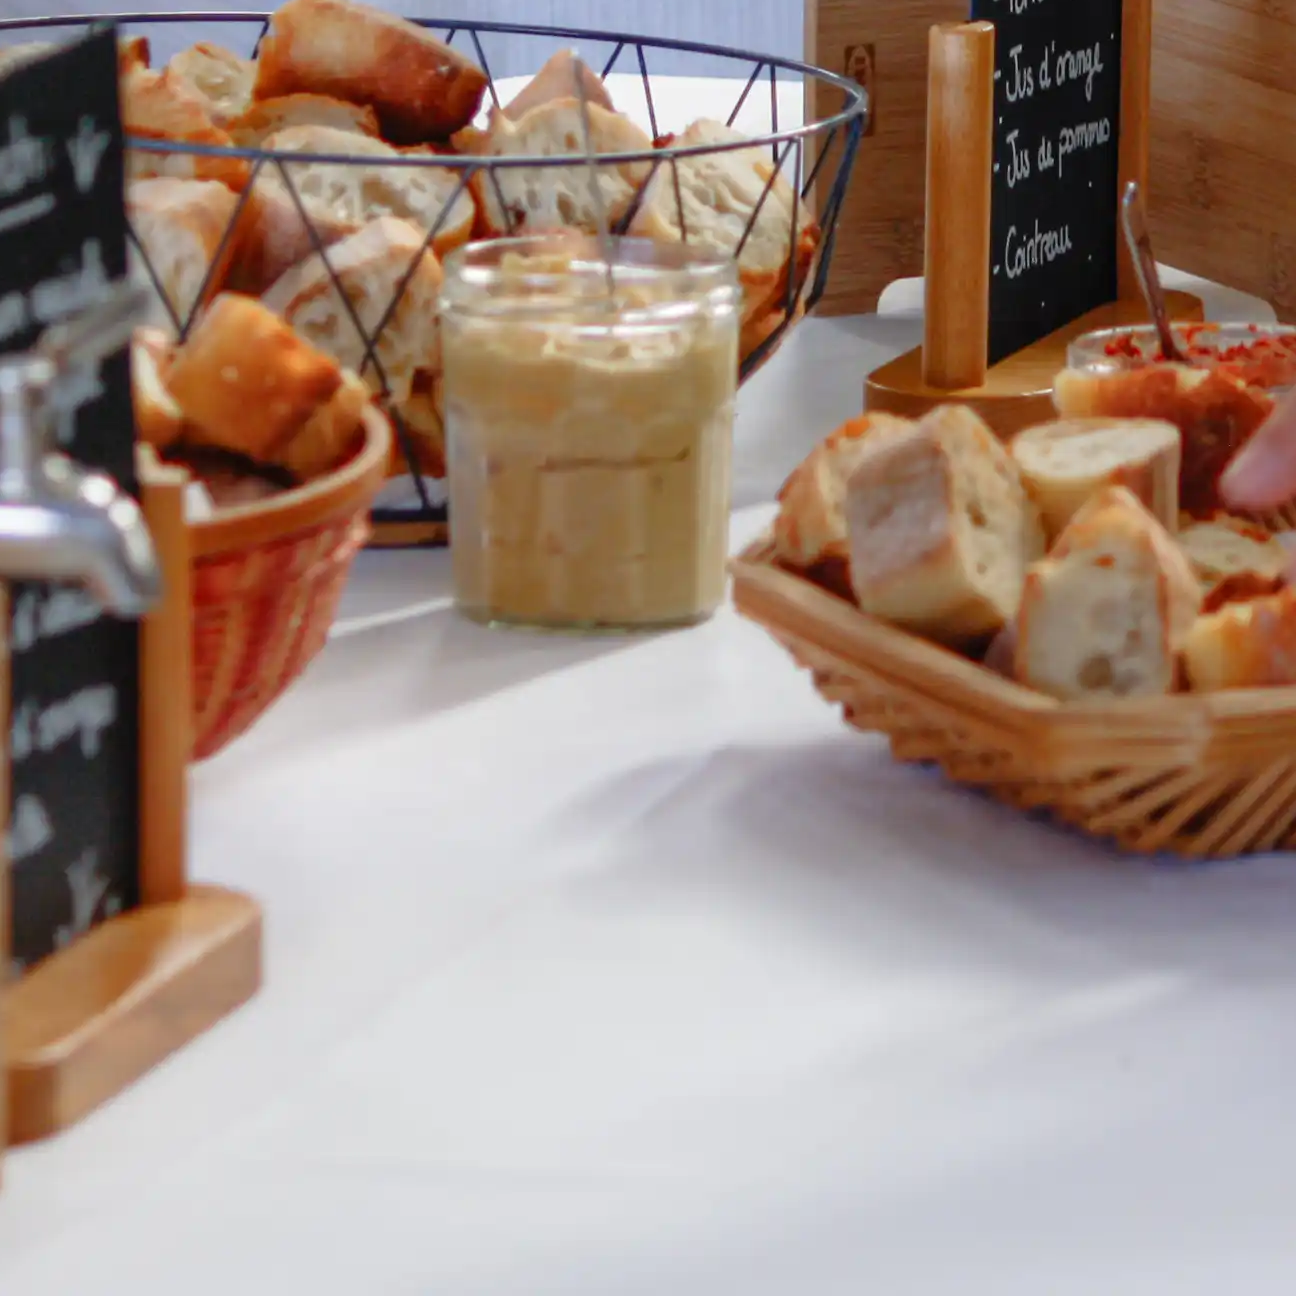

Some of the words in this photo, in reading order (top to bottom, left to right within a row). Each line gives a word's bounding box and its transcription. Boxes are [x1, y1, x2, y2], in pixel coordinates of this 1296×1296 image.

[1006, 44, 1034, 102] Jus
[1039, 40, 1103, 102] d'orange
[1006, 129, 1030, 188] Jus
[1037, 136, 1054, 172] de
[1005, 219, 1072, 279] Cointreau
